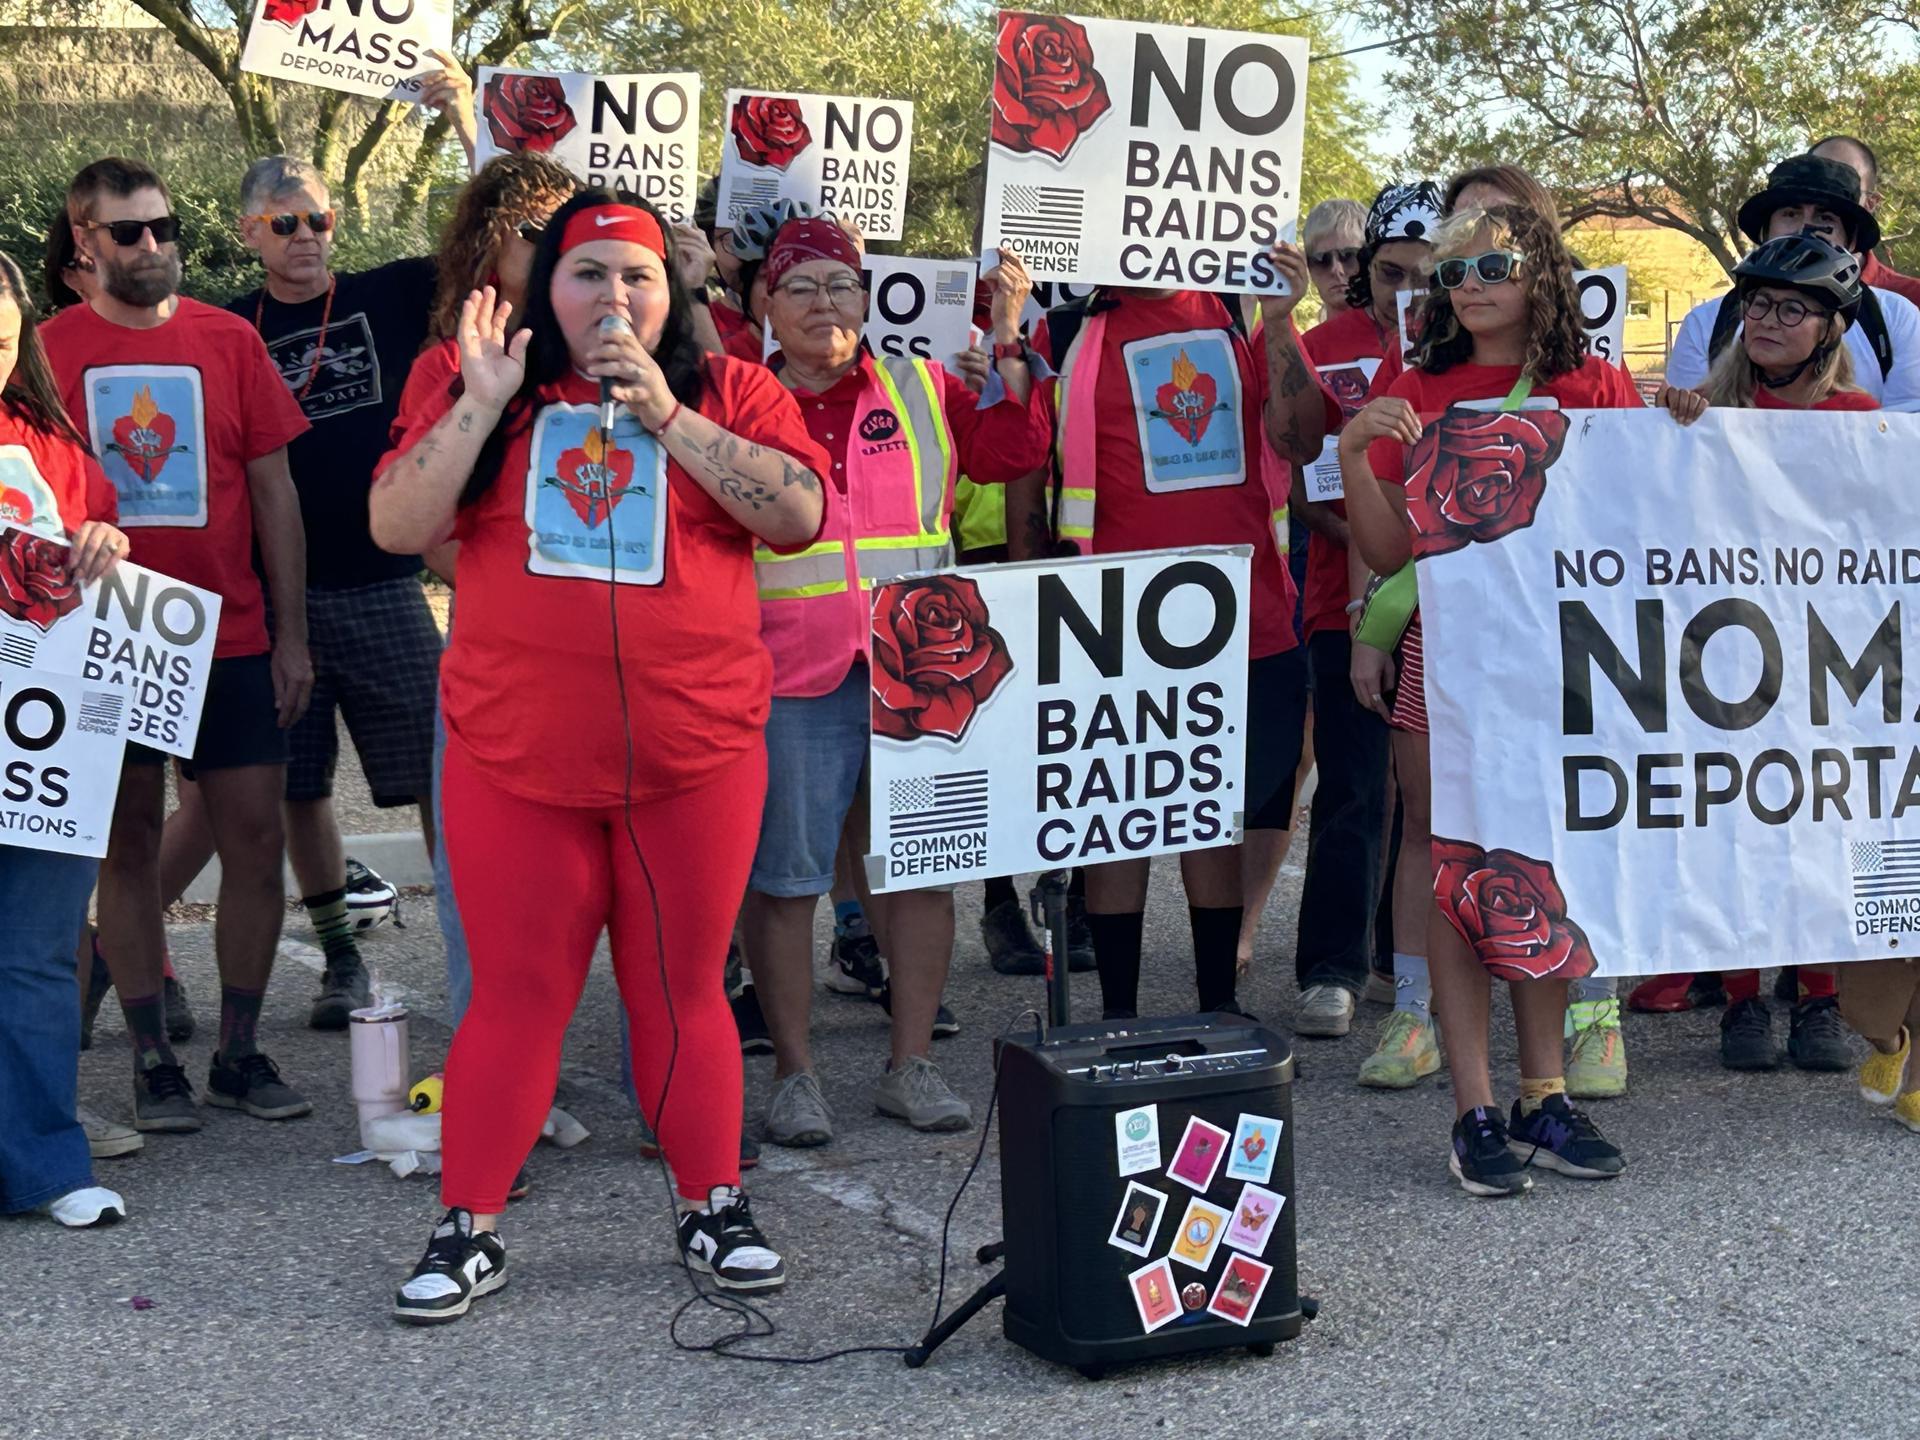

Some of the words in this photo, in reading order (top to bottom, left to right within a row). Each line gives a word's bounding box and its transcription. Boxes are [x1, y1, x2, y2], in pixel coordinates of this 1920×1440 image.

[298, 18, 420, 70] MASS
[280, 52, 422, 93] DEPORTATIONS
[1130, 32, 1296, 136] NO
[592, 81, 688, 134] NO
[824, 102, 903, 153] NO
[589, 142, 690, 170] BANS.
[822, 157, 900, 187] BANS.
[1126, 140, 1289, 199] BANS.
[821, 185, 897, 212] RAIDS.
[1000, 238, 1079, 256] COMMON
[1017, 255, 1079, 272] FENSE
[1119, 244, 1283, 289] CAGES.
[1554, 549, 1625, 588] NO
[1646, 547, 1765, 586] BANS.
[1775, 547, 1824, 585] NO
[95, 566, 206, 646] NO
[1037, 561, 1237, 686] NO
[87, 626, 195, 691] BANS.
[1558, 597, 1784, 735] NO
[1807, 600, 1920, 726] M
[1037, 681, 1235, 755] BANS.
[1037, 743, 1234, 812] RAIDS.
[890, 831, 987, 858] COMMON
[1036, 800, 1233, 862] CAGES.
[890, 851, 987, 878] DEFENSE
[1855, 898, 1920, 917] COMMO
